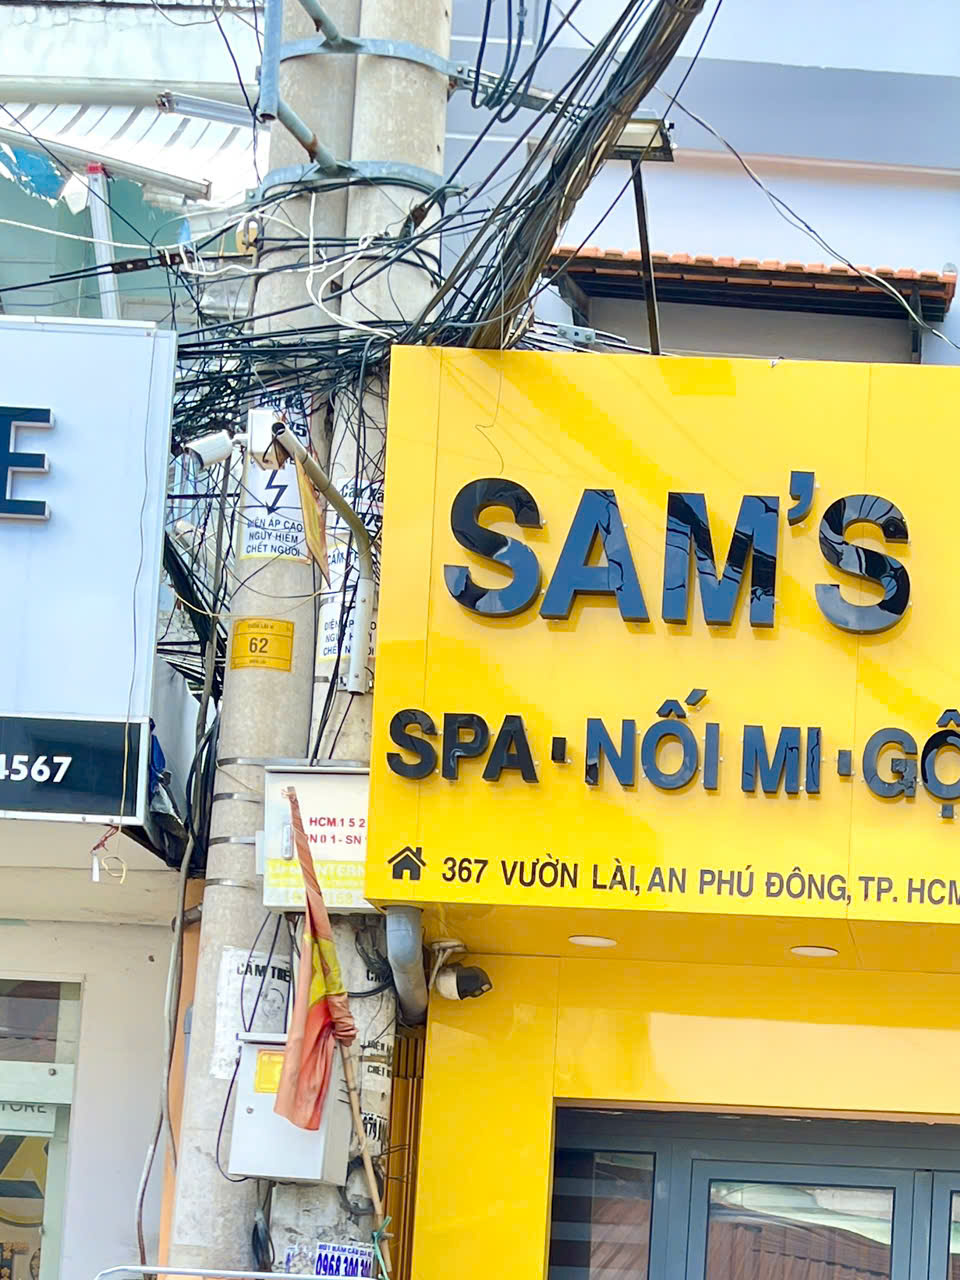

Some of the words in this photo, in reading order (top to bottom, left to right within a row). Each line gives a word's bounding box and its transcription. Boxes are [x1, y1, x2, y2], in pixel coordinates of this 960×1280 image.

[444, 471, 911, 635] SAM'S
[249, 637, 269, 654] 62
[386, 708, 540, 783] SPA
[585, 689, 719, 791] NỐI
[741, 726, 821, 794] MI
[441, 856, 488, 885] 367
[501, 852, 579, 889] VƯỜN
[699, 863, 755, 898] PHÚ
